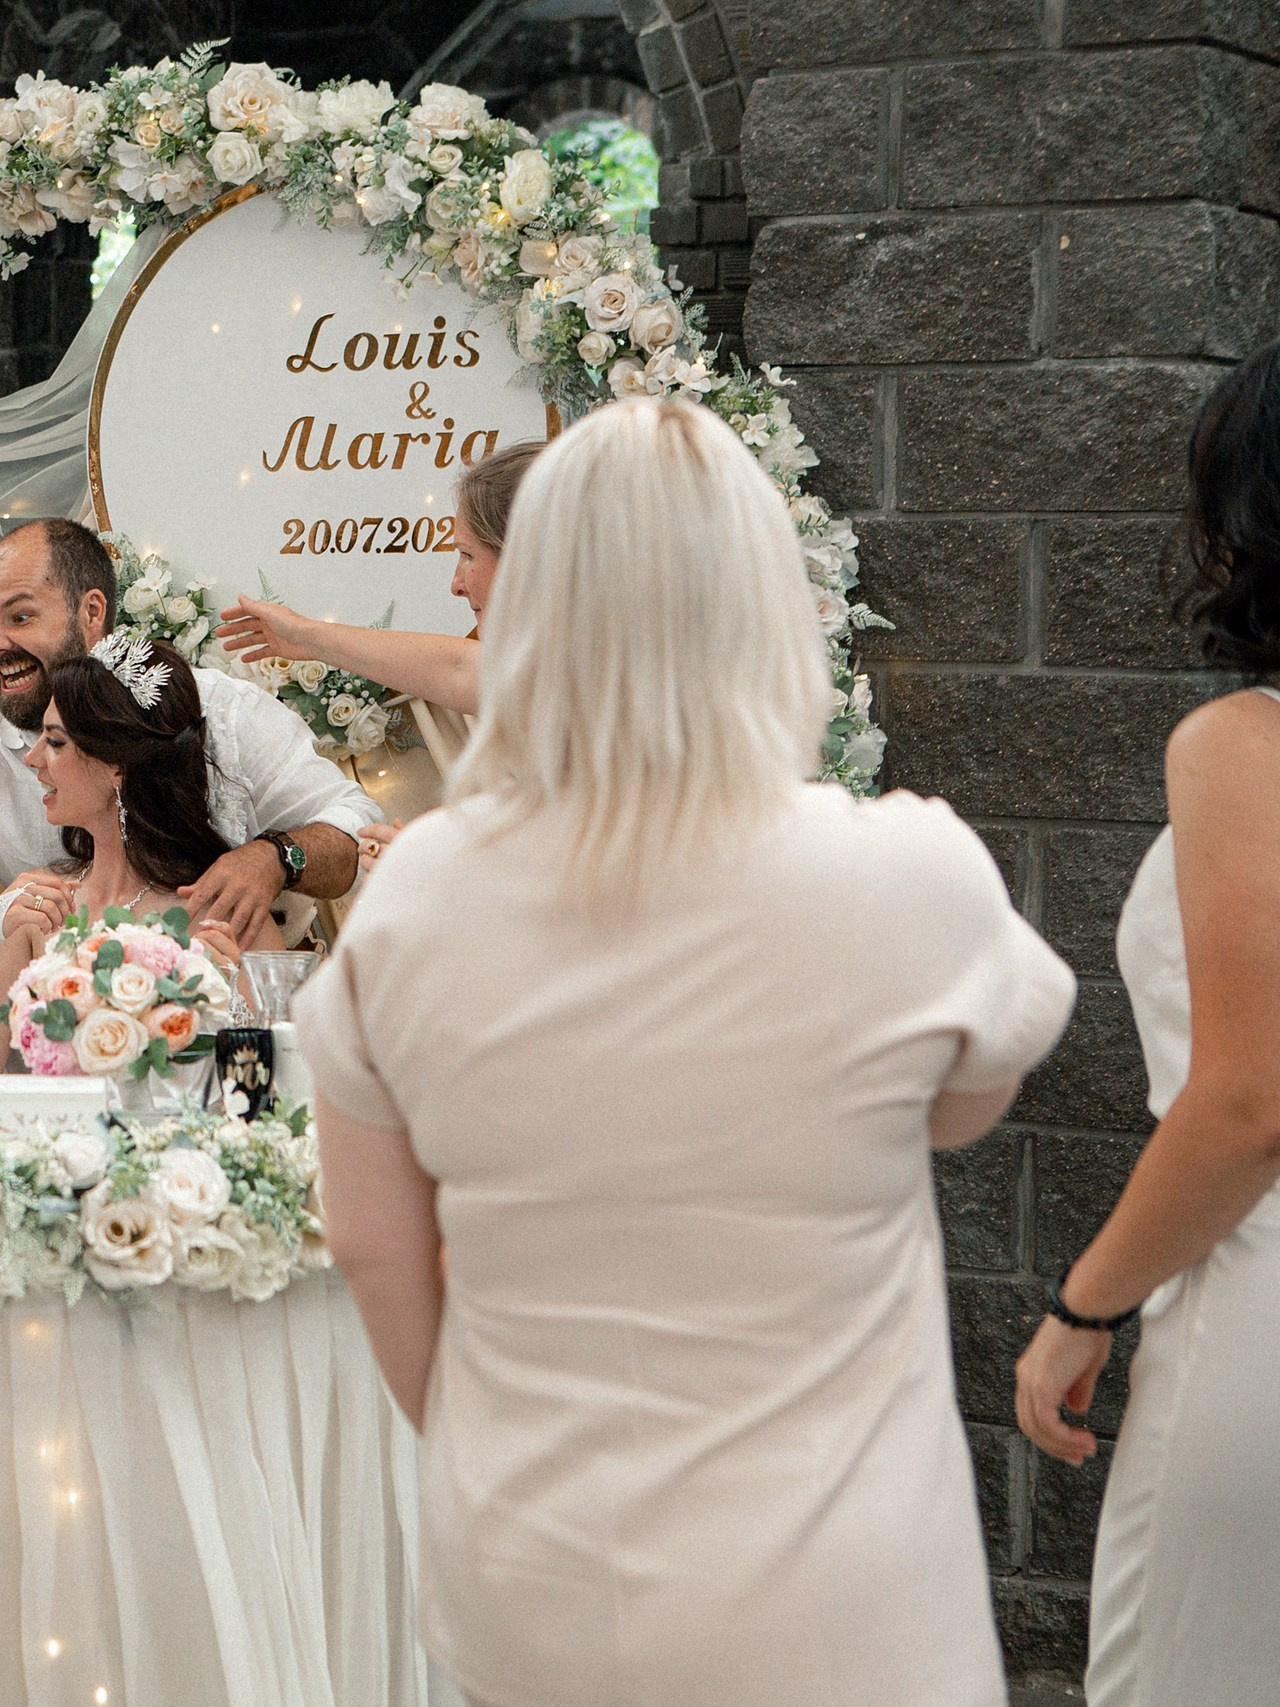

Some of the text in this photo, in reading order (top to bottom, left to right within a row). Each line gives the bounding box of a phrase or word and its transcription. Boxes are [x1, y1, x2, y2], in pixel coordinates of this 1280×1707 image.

[285, 312, 480, 373] Louis
[405, 381, 437, 420] &
[262, 415, 500, 473] Maria
[279, 515, 456, 555] 20.07.202
